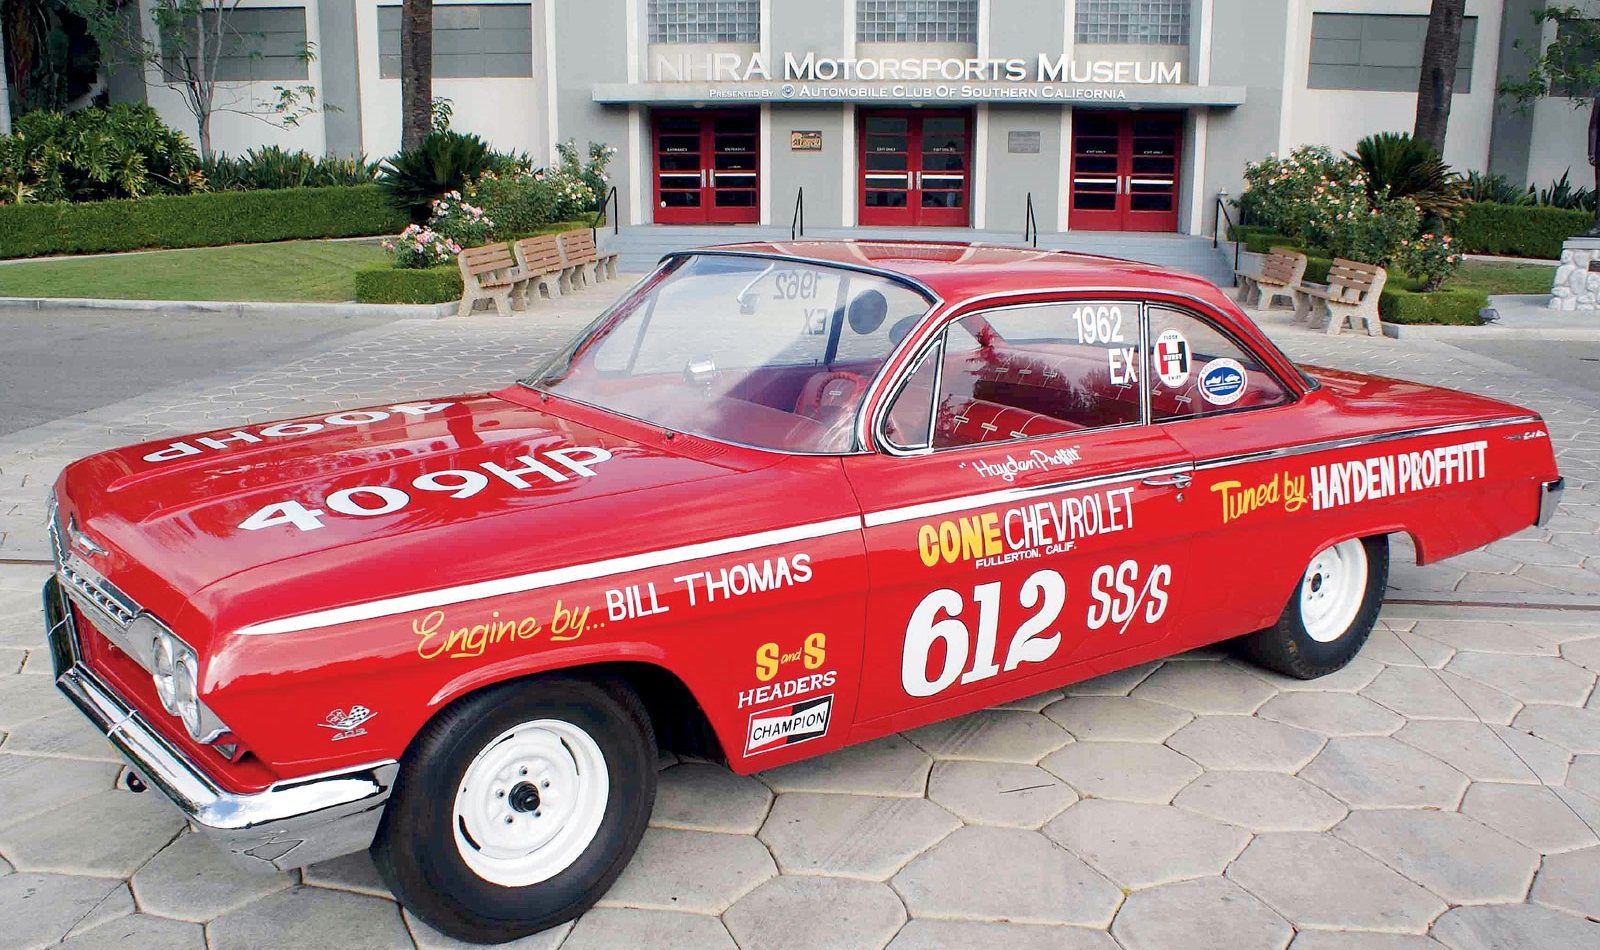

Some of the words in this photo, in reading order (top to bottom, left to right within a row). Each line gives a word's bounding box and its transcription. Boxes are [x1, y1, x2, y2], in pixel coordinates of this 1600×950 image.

[657, 52, 772, 81] NHRA
[1072, 306, 1124, 345] 1962
[1108, 346, 1138, 385] EX
[237, 446, 614, 533] 409HP
[1210, 470, 1280, 524] Tuned
[1310, 455, 1396, 511] HAYDEN
[1397, 440, 1489, 494] PROFFITT
[917, 511, 1004, 568] CONE
[1003, 486, 1135, 551] CHEVROLET
[412, 610, 542, 660] Engine
[605, 583, 670, 622] BILL
[673, 553, 813, 607] THOMAS
[901, 568, 1067, 698] 612
[1086, 559, 1172, 635] SS/S
[755, 642, 780, 682] S
[780, 646, 803, 664] and
[804, 632, 826, 670] S
[737, 670, 838, 709] HEADERS
[753, 710, 826, 741] CHAMPION
